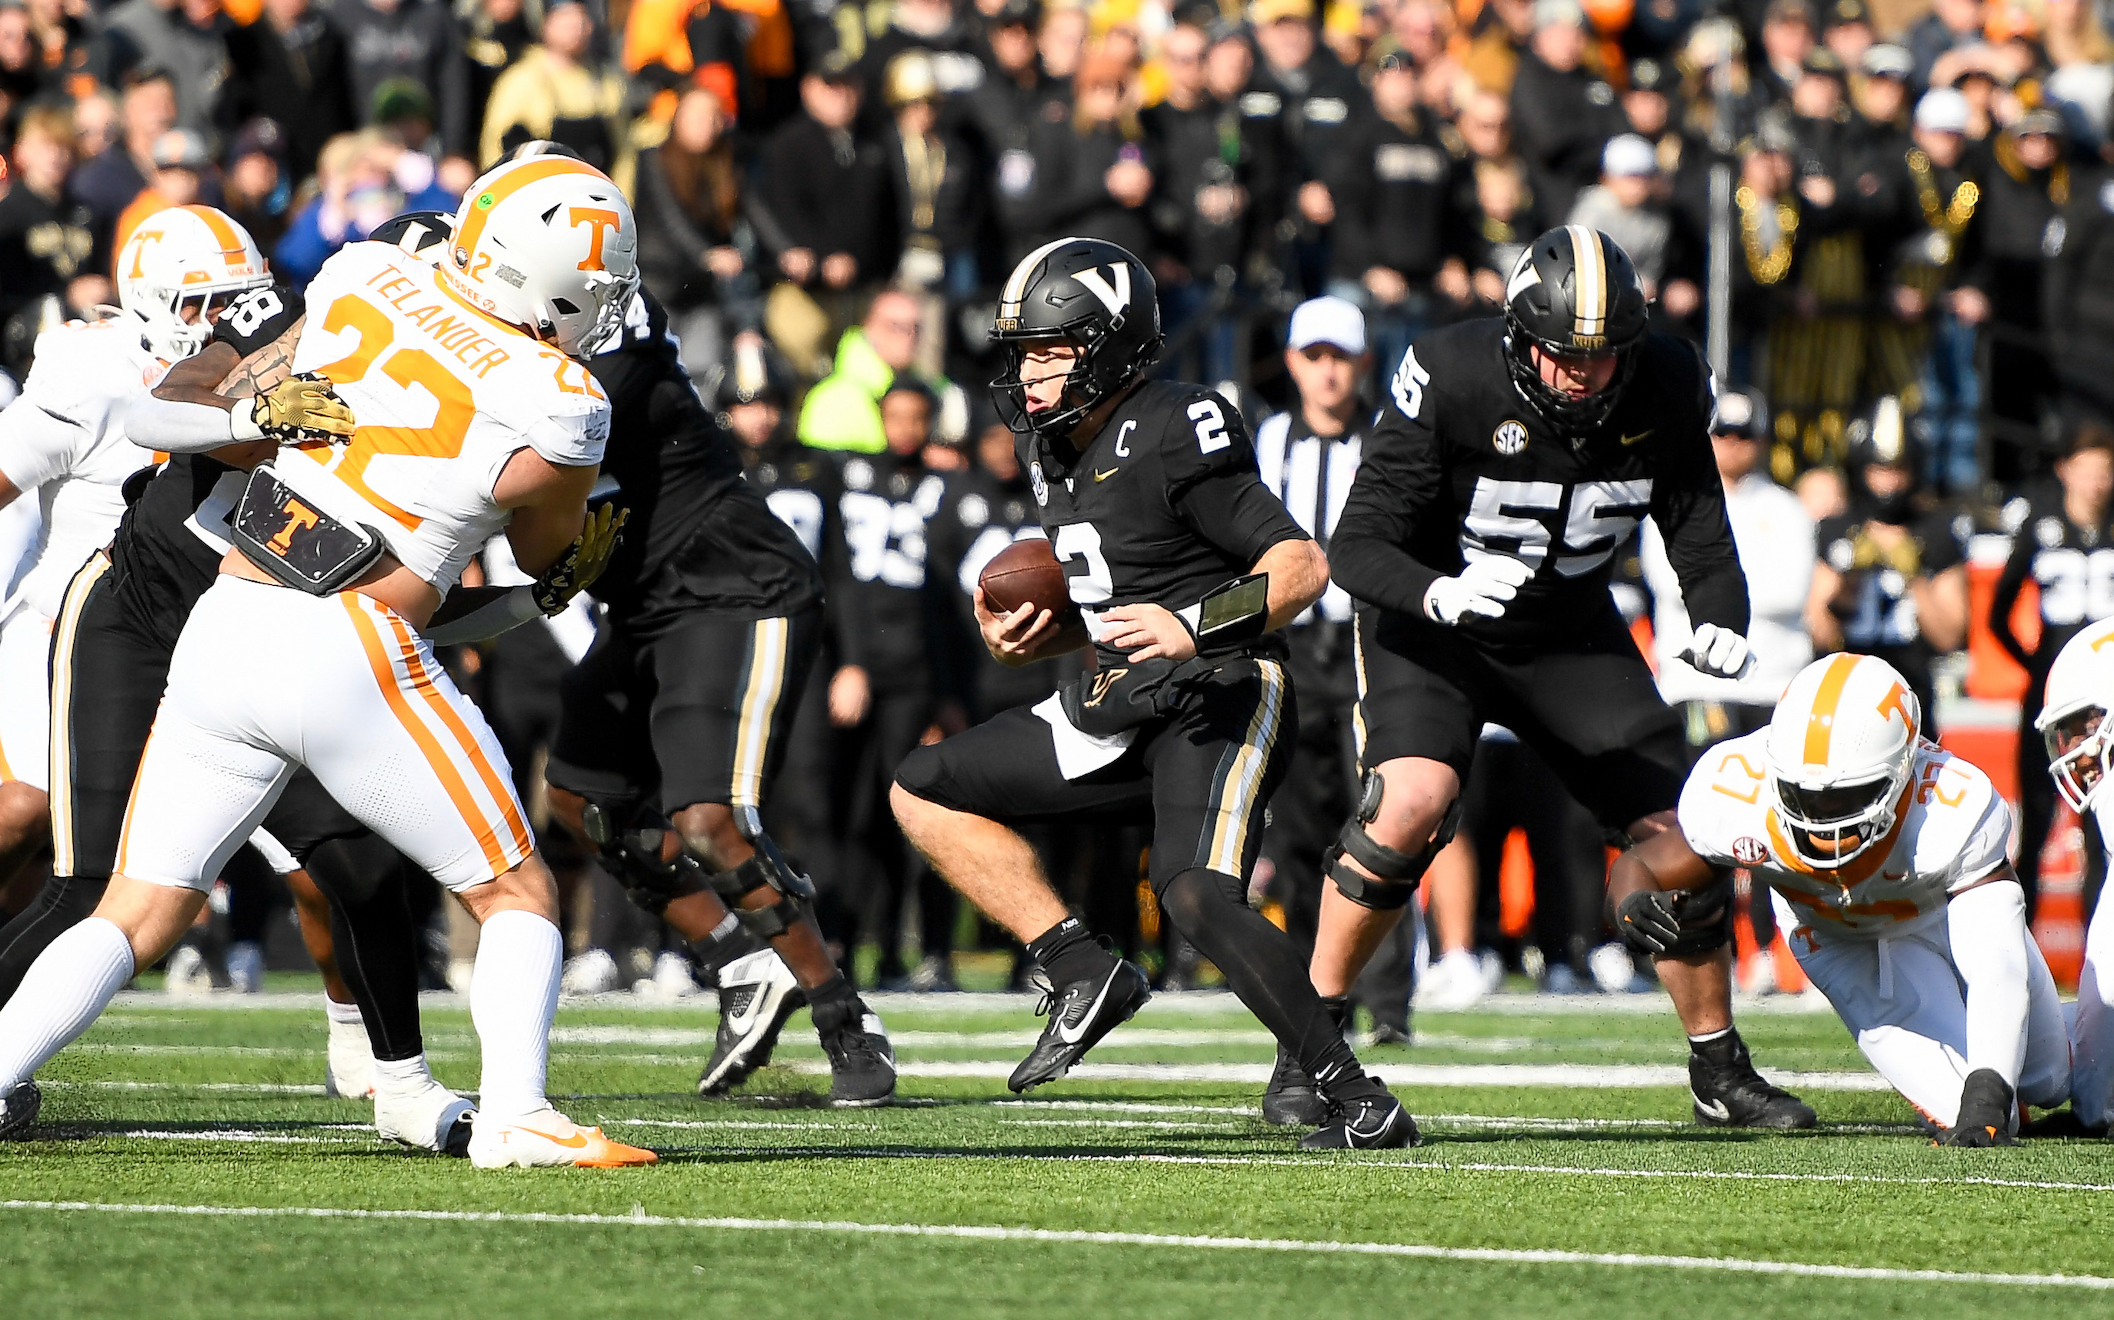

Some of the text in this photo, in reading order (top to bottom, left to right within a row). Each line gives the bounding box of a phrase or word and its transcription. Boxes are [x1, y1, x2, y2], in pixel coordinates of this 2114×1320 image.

[129, 231, 165, 279] T
[569, 207, 621, 271] T
[470, 252, 492, 283] 2
[1071, 261, 1131, 315] V
[1507, 246, 1541, 302] V
[366, 264, 510, 379] TELANDER
[300, 293, 476, 532] 22
[1115, 420, 1137, 457] C
[1187, 400, 1231, 455] 2
[1496, 422, 1526, 453] SEC
[273, 498, 319, 548] T
[1459, 476, 1654, 579] 55
[1055, 521, 1124, 643] 2
[498, 1131, 511, 1143] T
